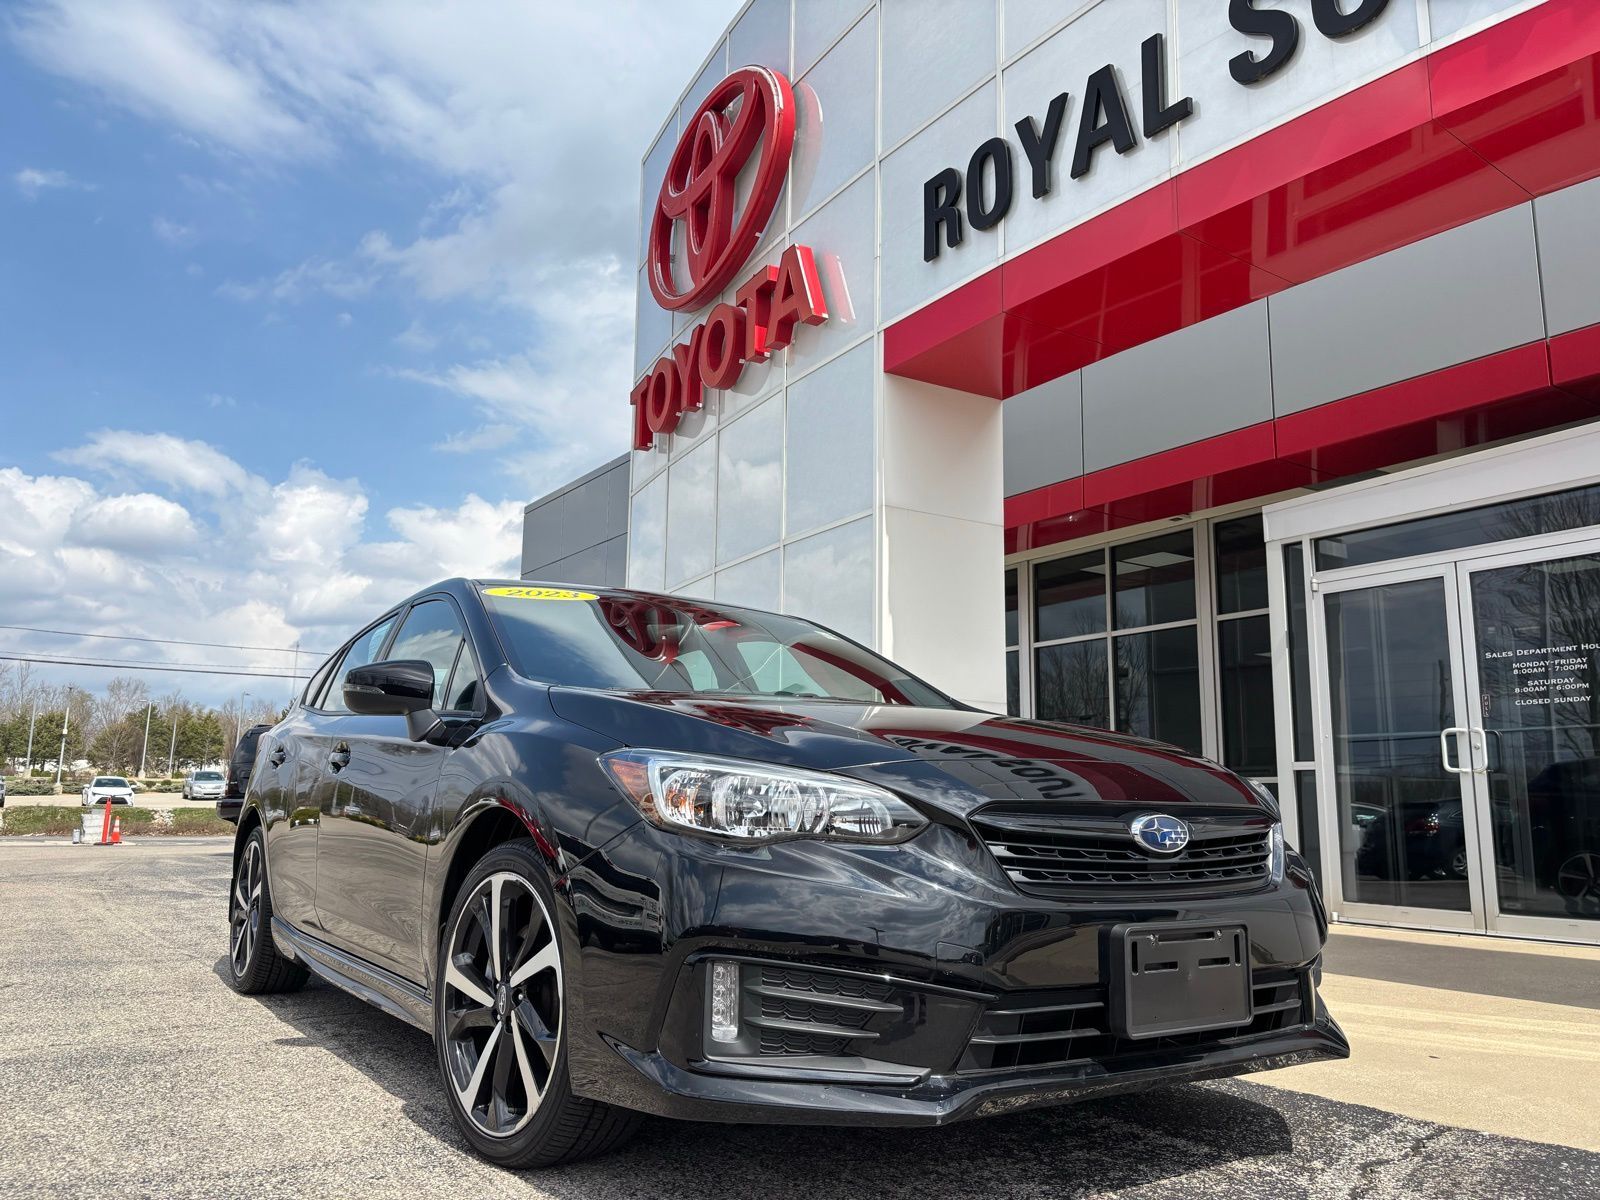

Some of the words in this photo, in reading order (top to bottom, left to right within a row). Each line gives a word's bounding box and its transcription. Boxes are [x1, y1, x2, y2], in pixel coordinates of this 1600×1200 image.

[924, 33, 1193, 262] ROYAL
[630, 243, 828, 451] TOYOTA
[508, 589, 579, 598] 2023
[1513, 657, 1588, 668] MONDAY-FRIDAY
[1513, 666, 1545, 675] 8:00AM
[1554, 663, 1588, 672] 7:00PM
[1527, 678, 1575, 686] SATURDAY
[1514, 685, 1547, 693] 8:00AM
[1556, 683, 1590, 691] 6:00PM
[1554, 696, 1591, 704] SUNDAY
